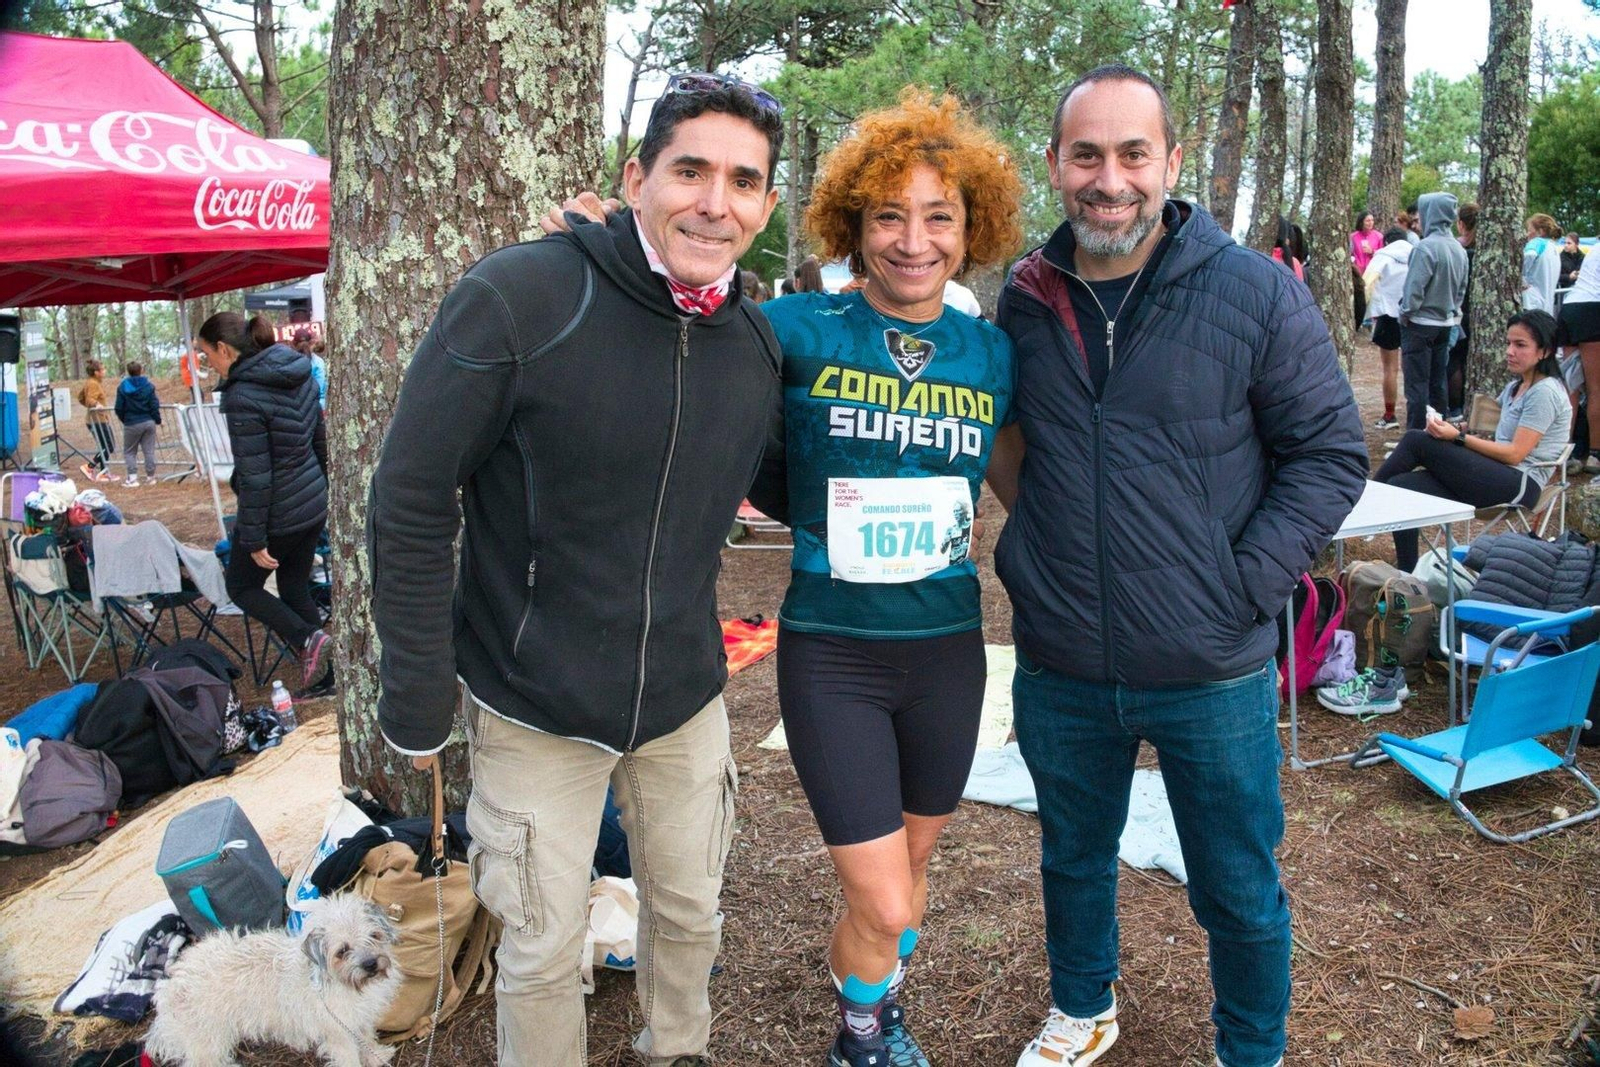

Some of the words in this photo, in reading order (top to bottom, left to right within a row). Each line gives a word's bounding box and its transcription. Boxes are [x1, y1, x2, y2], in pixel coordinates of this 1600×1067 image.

[194, 176, 317, 230] Coca-Cola
[810, 366, 994, 425] COMANDO
[828, 406, 982, 464] SUREÑO
[862, 505, 900, 514] COMANDO
[902, 503, 932, 513] SUREÑO
[858, 521, 935, 558] 1674
